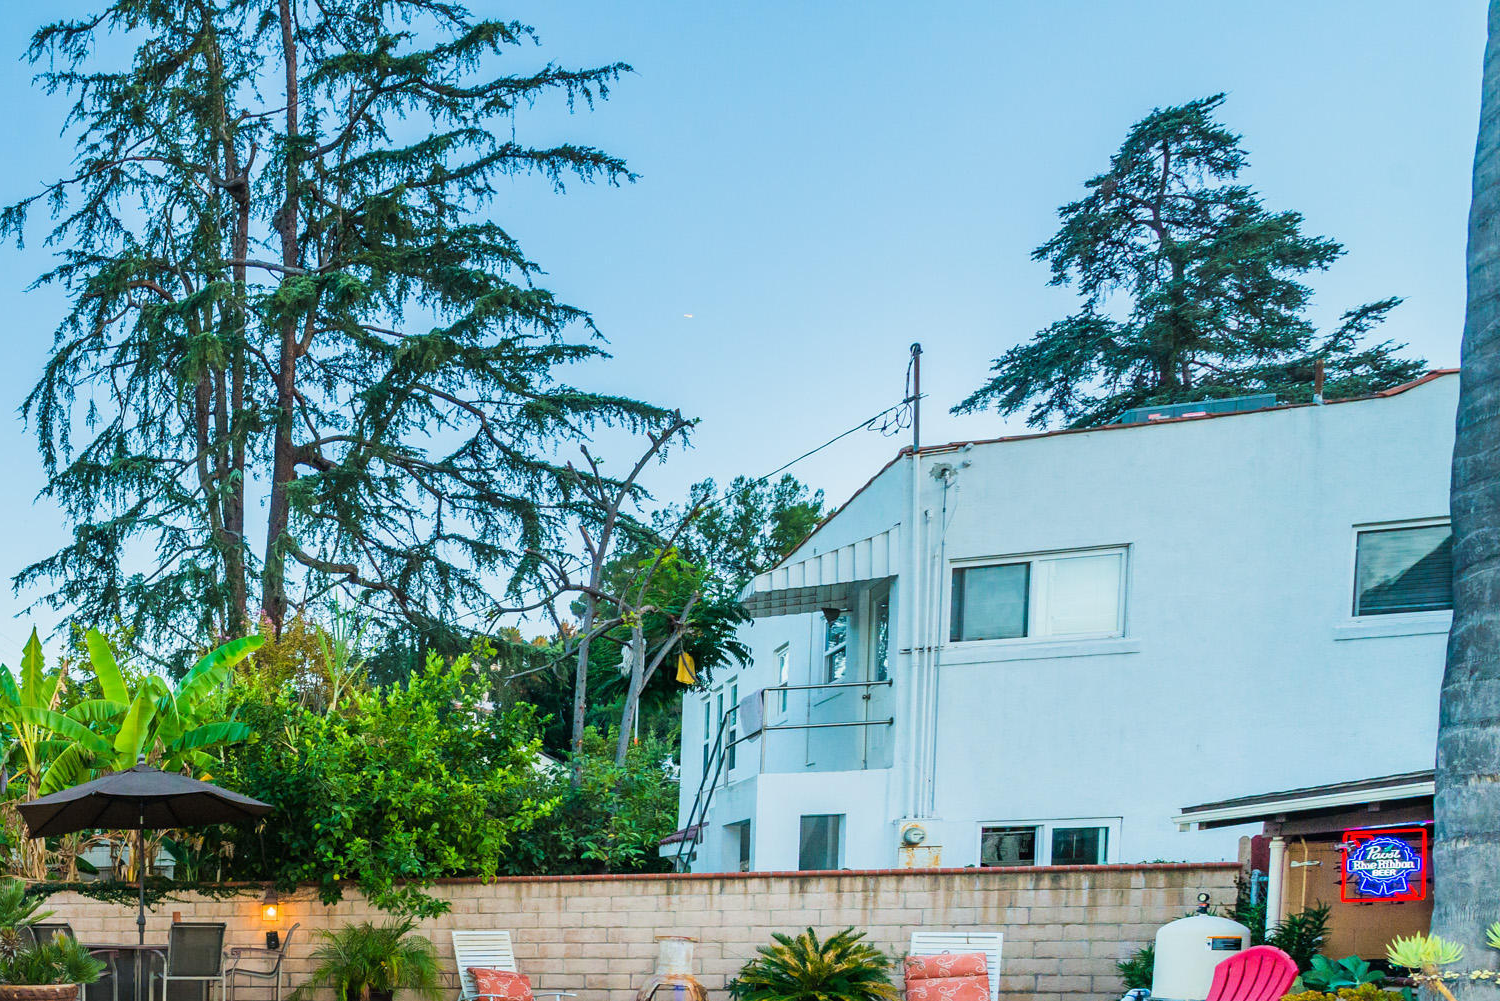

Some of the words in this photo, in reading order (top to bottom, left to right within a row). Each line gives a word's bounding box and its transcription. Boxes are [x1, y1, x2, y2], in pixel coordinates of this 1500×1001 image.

[1353, 860, 1377, 870] Blue
[1377, 859, 1415, 869] Ribbon
[1372, 869, 1397, 877] BEER
